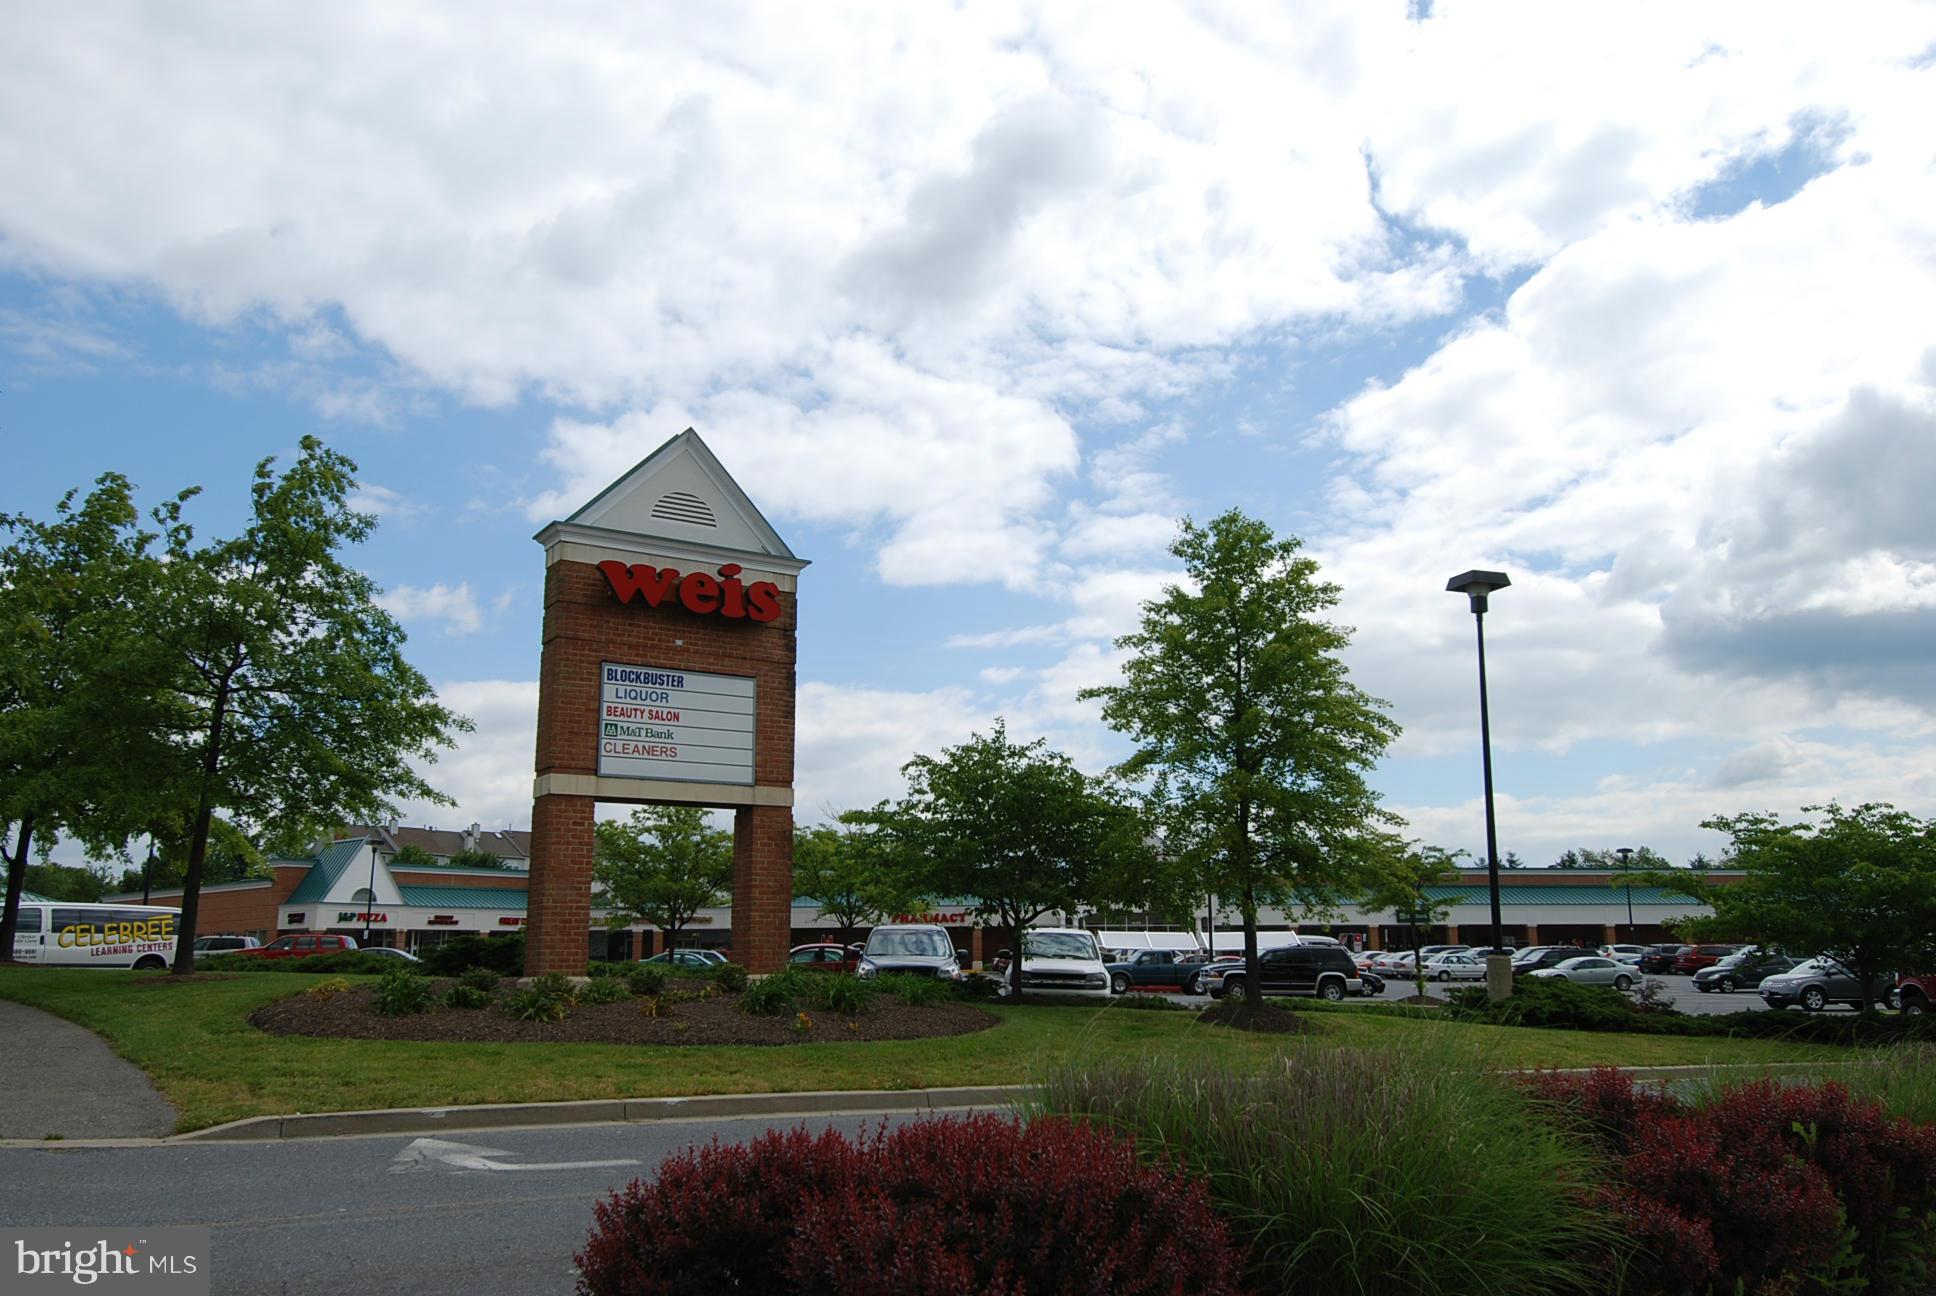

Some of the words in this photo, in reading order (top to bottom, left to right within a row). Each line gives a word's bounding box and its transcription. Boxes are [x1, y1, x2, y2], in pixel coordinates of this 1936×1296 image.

[606, 667, 685, 688] BLOCKBUSTER
[615, 687, 670, 704] LIQUOR
[606, 705, 646, 720] BEAUTY
[647, 709, 681, 723] SALON
[619, 725, 644, 738] M&T
[644, 727, 675, 740] Bank
[603, 741, 678, 759] CLEANERS
[357, 912, 388, 923] PIZZA
[57, 916, 174, 949] CELEBREE
[90, 944, 133, 957] LEARNING
[136, 941, 174, 954] CENTERS
